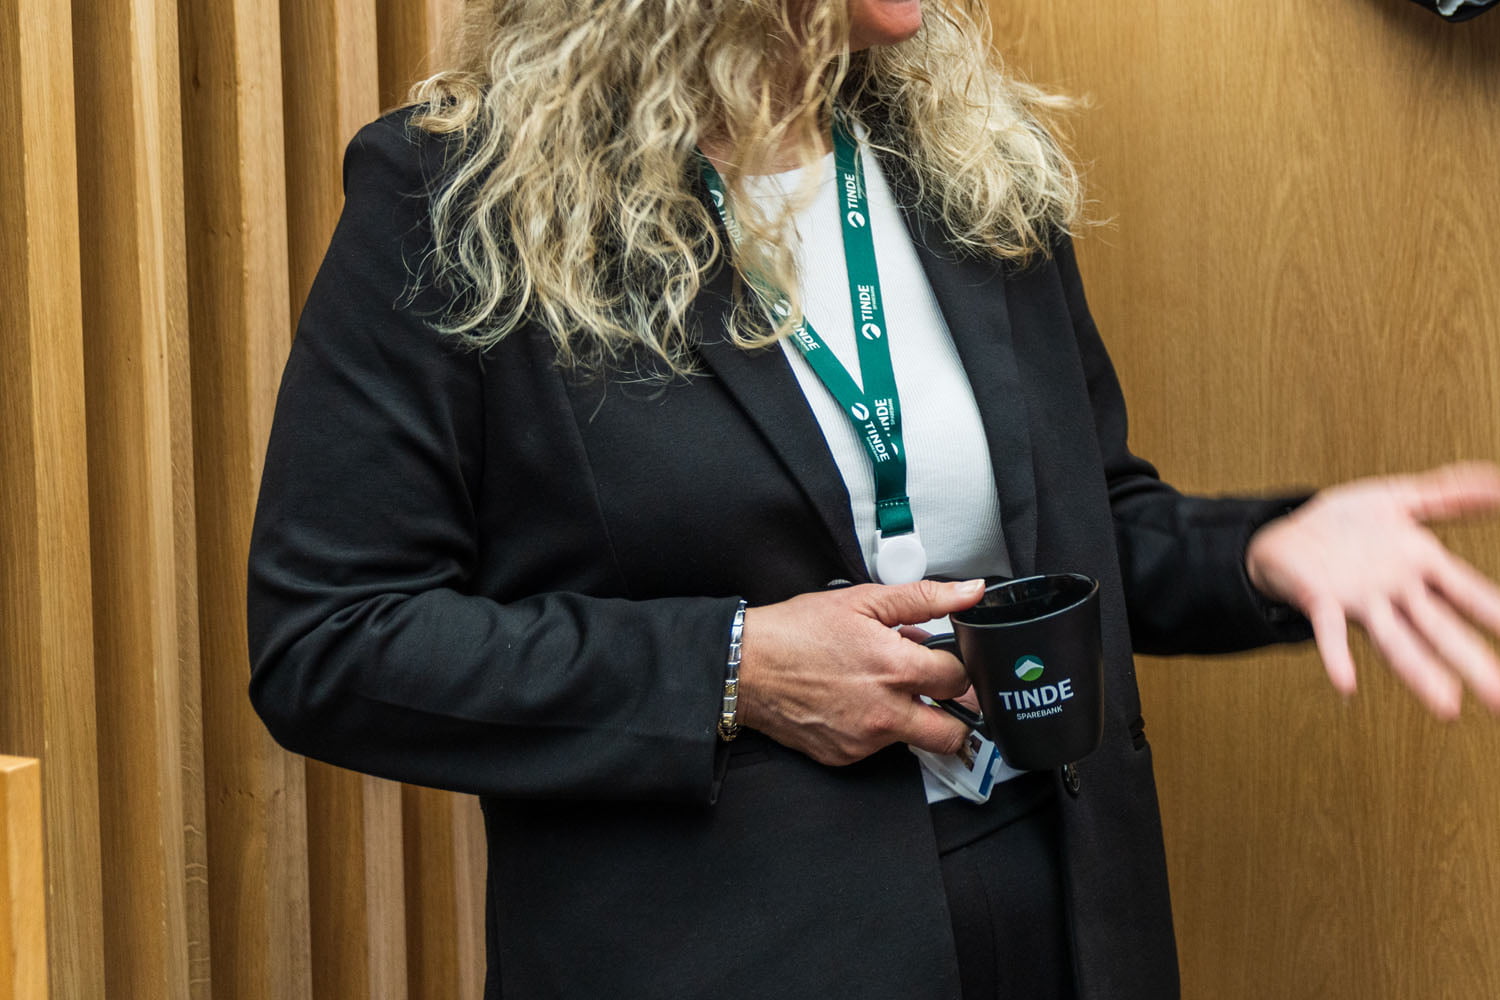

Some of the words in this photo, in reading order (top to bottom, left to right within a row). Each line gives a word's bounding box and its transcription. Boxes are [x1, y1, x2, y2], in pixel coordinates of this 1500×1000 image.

[844, 172, 859, 209] TINDE
[857, 284, 874, 322] TINDE
[791, 322, 821, 351] INDE
[874, 398, 892, 437] INDE
[864, 420, 890, 462] TINDE
[998, 678, 1074, 711] TINDE
[1016, 704, 1063, 721] SPAREBANK
